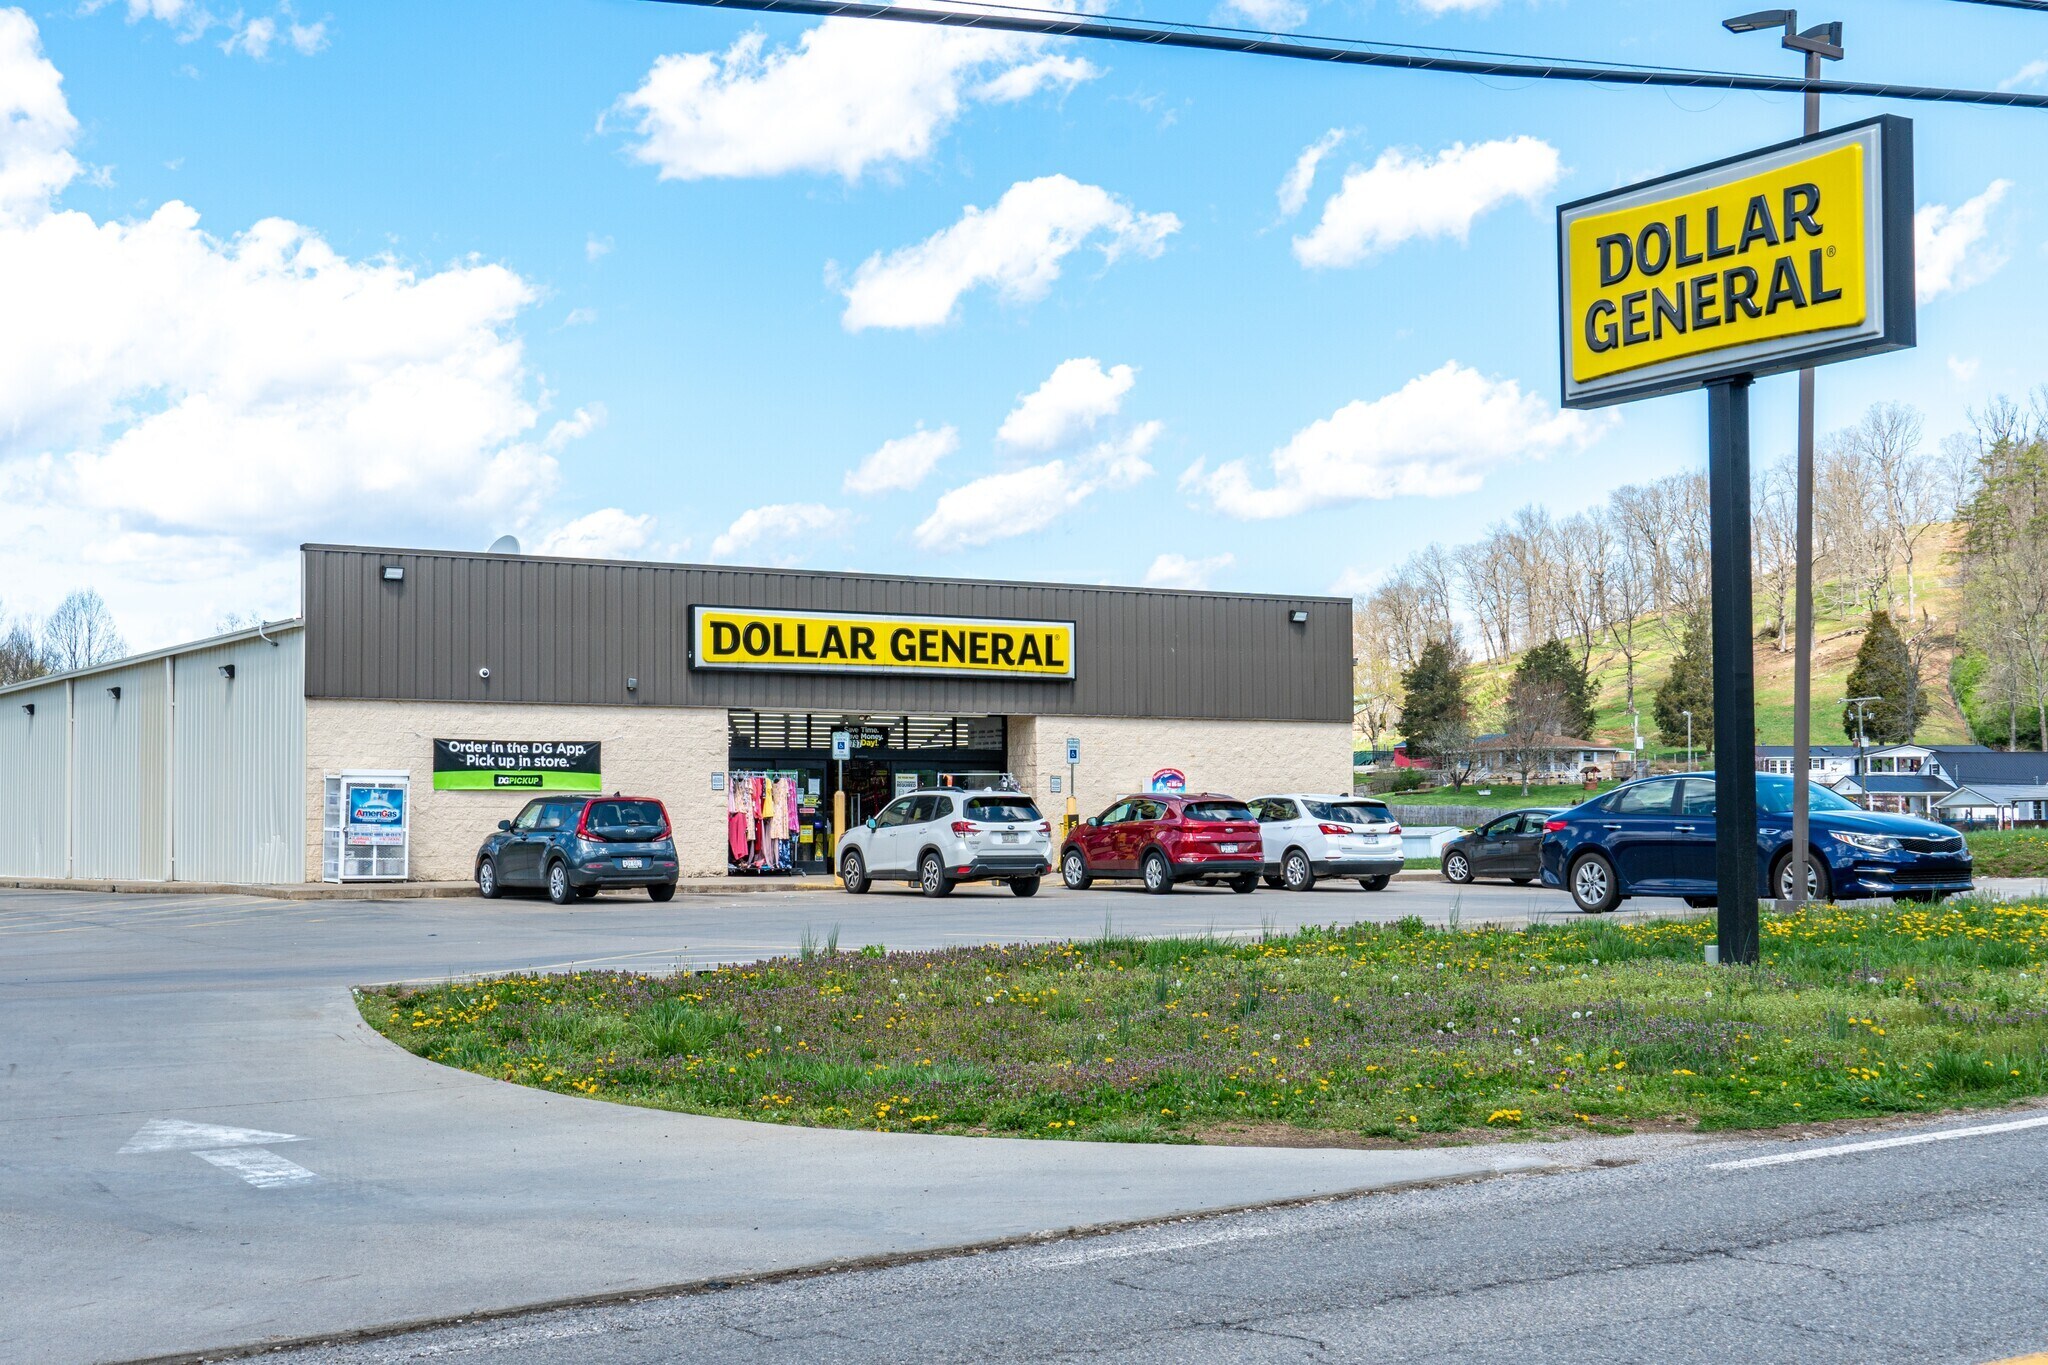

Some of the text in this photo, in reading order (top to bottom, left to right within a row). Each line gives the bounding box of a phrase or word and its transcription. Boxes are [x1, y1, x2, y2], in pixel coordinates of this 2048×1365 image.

[1596, 182, 1824, 288] DOLLAR
[1584, 248, 1843, 353] GENERAL
[710, 620, 1065, 667] DOLLAR GENERAL
[448, 741, 587, 757] Order in the DG App.
[466, 754, 570, 768] Pick up in store.
[356, 809, 398, 818] AmeriGas
